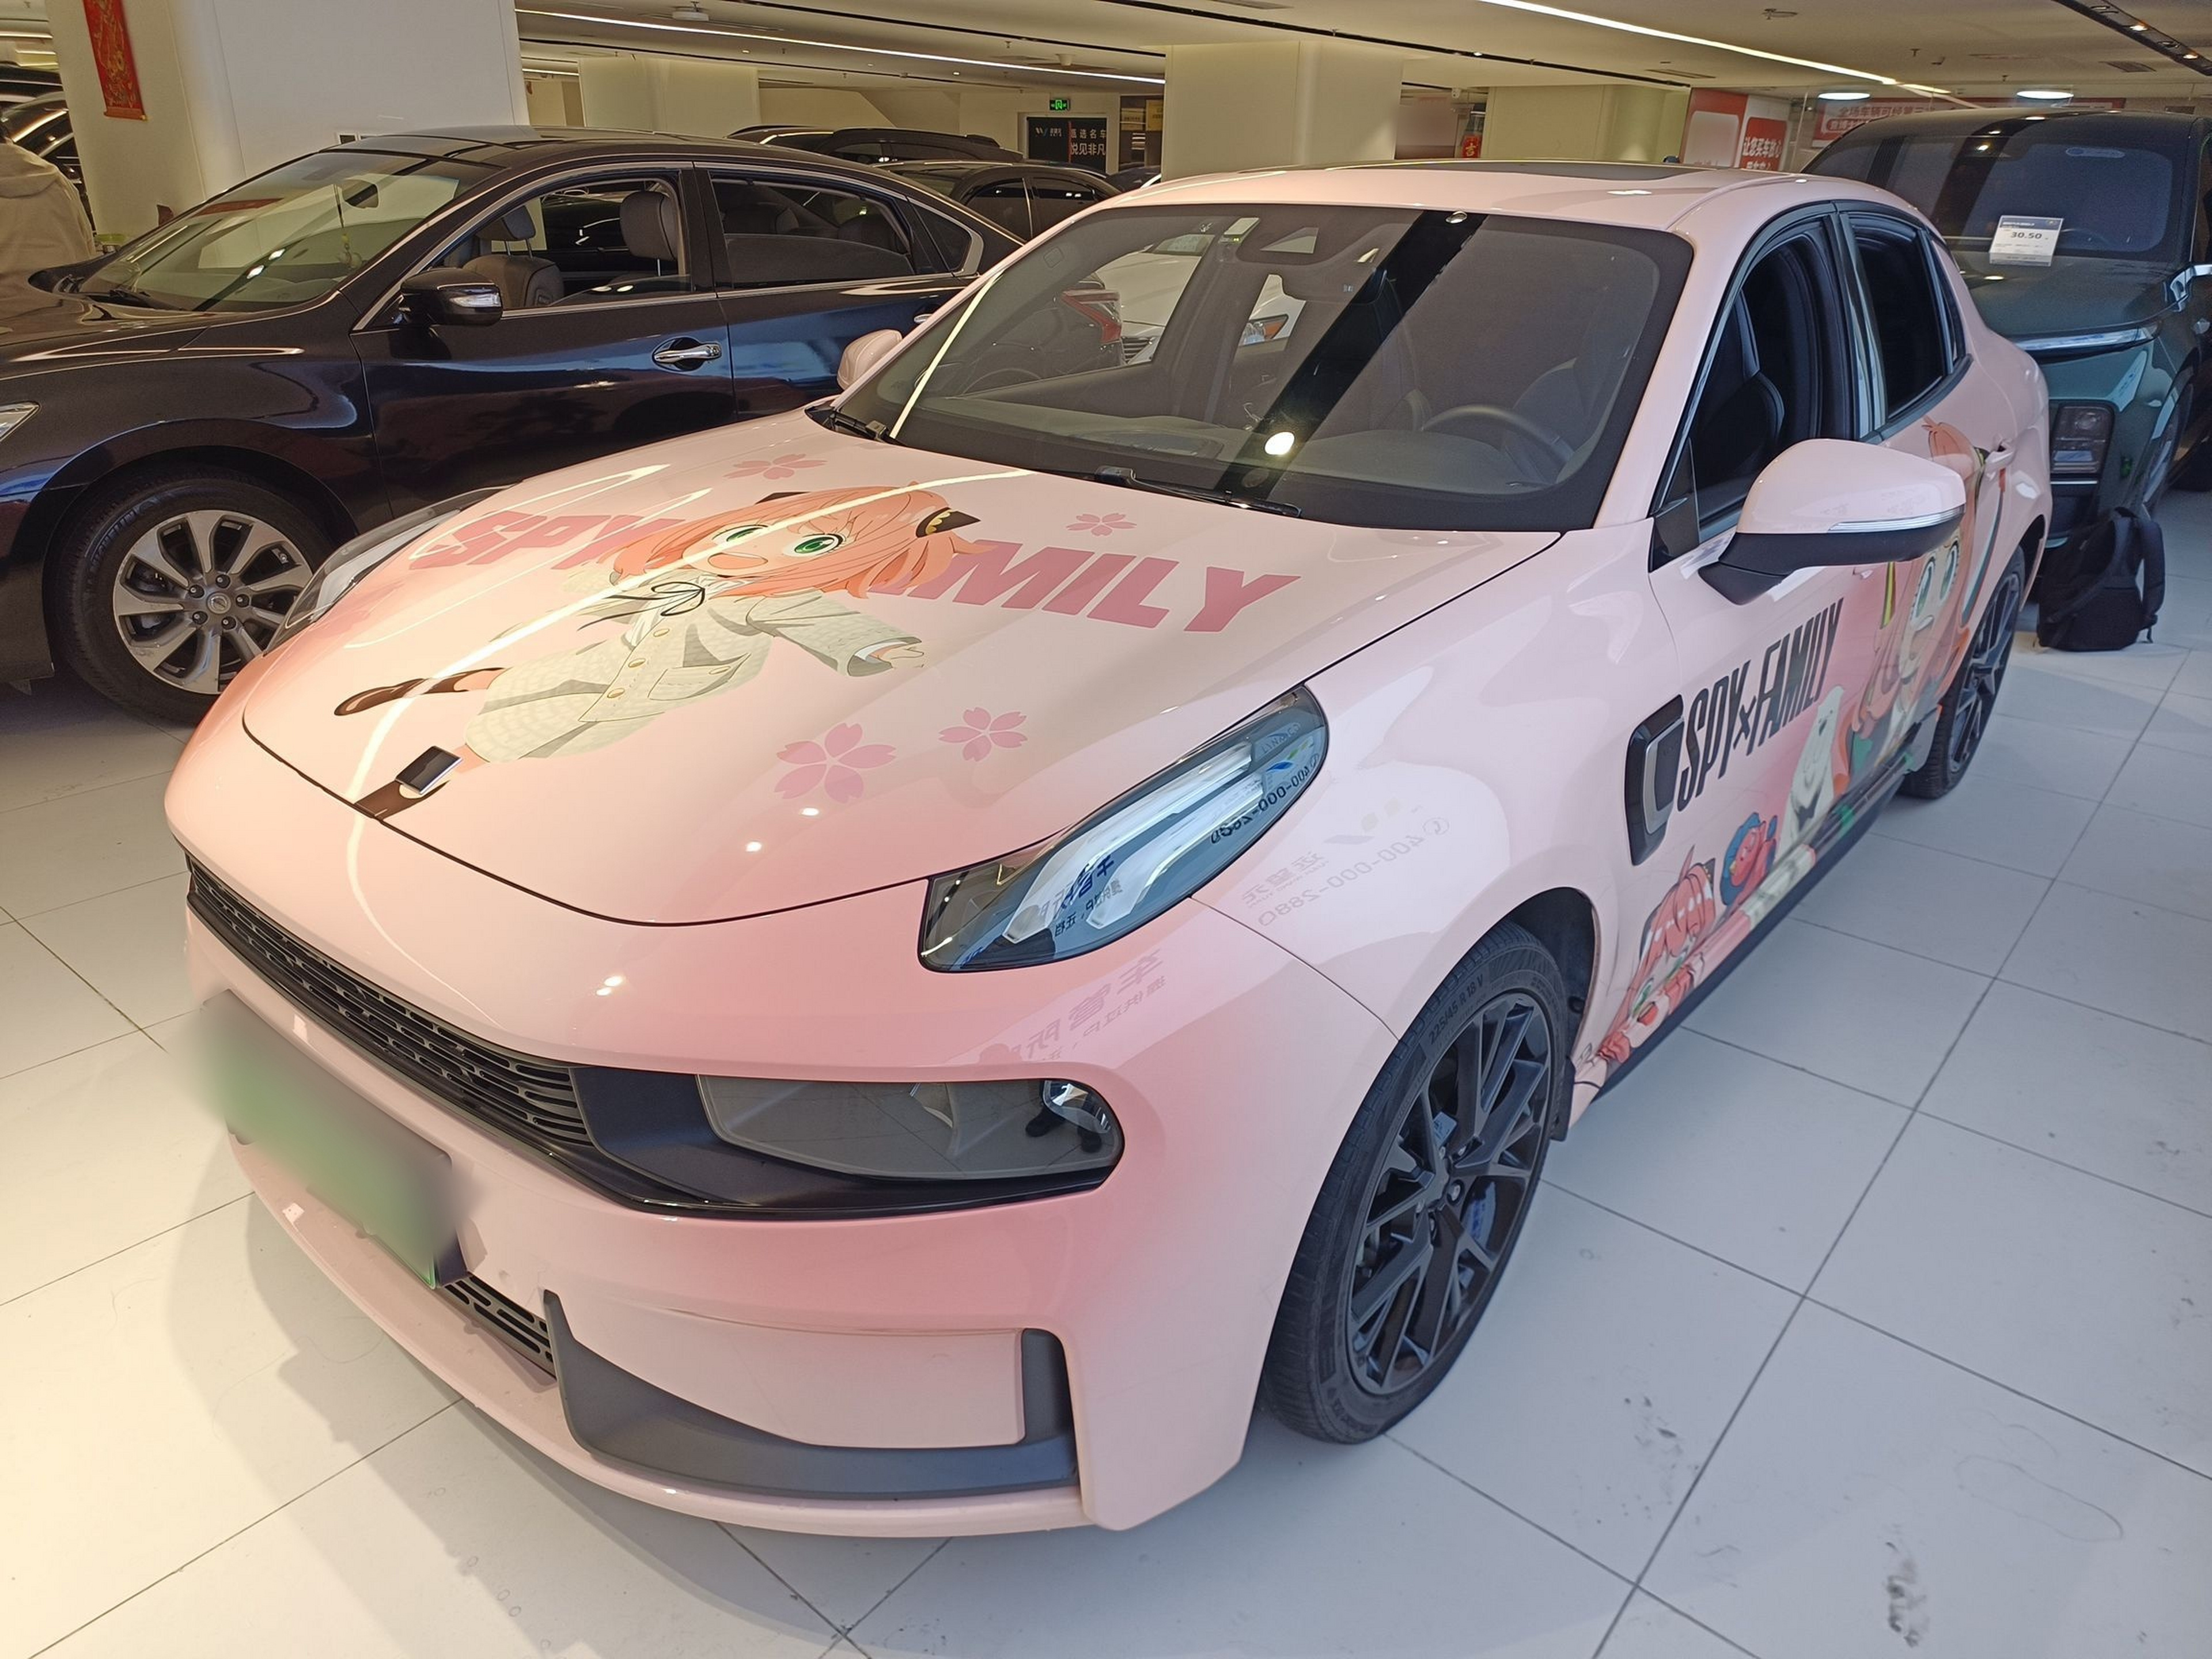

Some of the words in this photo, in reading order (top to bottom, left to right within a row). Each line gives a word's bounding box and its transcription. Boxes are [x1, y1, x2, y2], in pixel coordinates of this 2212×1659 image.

[2011, 232, 2042, 240] 30.50
[408, 510, 687, 570] SPY
[867, 539, 1302, 632] MILY
